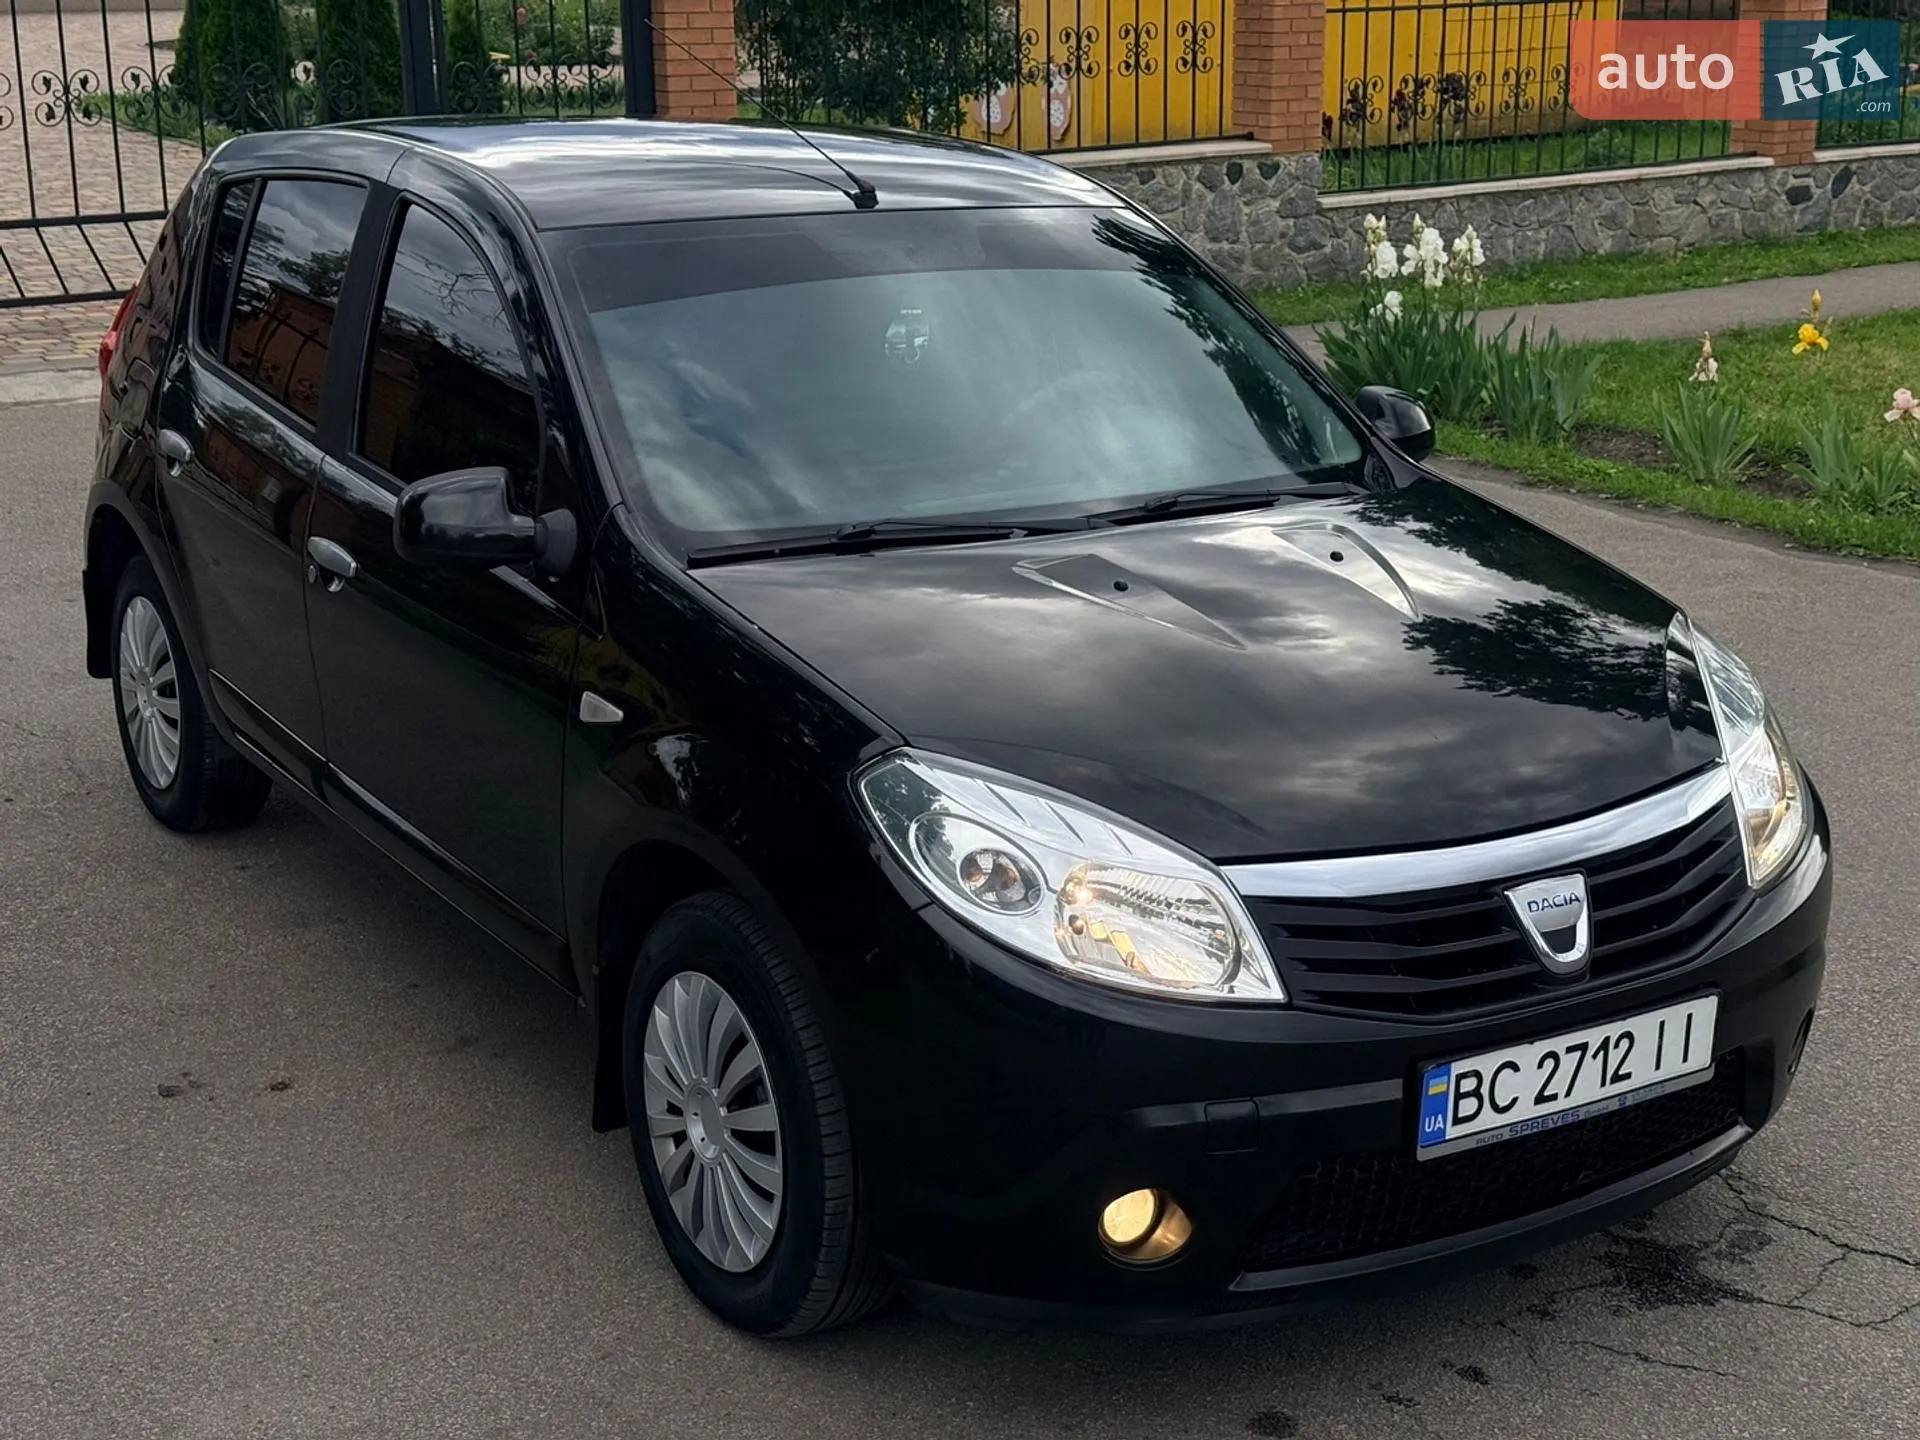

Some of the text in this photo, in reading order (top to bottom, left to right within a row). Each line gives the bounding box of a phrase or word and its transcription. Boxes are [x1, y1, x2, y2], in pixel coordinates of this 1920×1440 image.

[1527, 892, 1581, 913] DACIA
[1451, 1060, 1521, 1127] BC
[1533, 1030, 1635, 1106] 2712
[1425, 1113, 1444, 1132] UA
[1508, 1109, 1581, 1137] SPREVES
